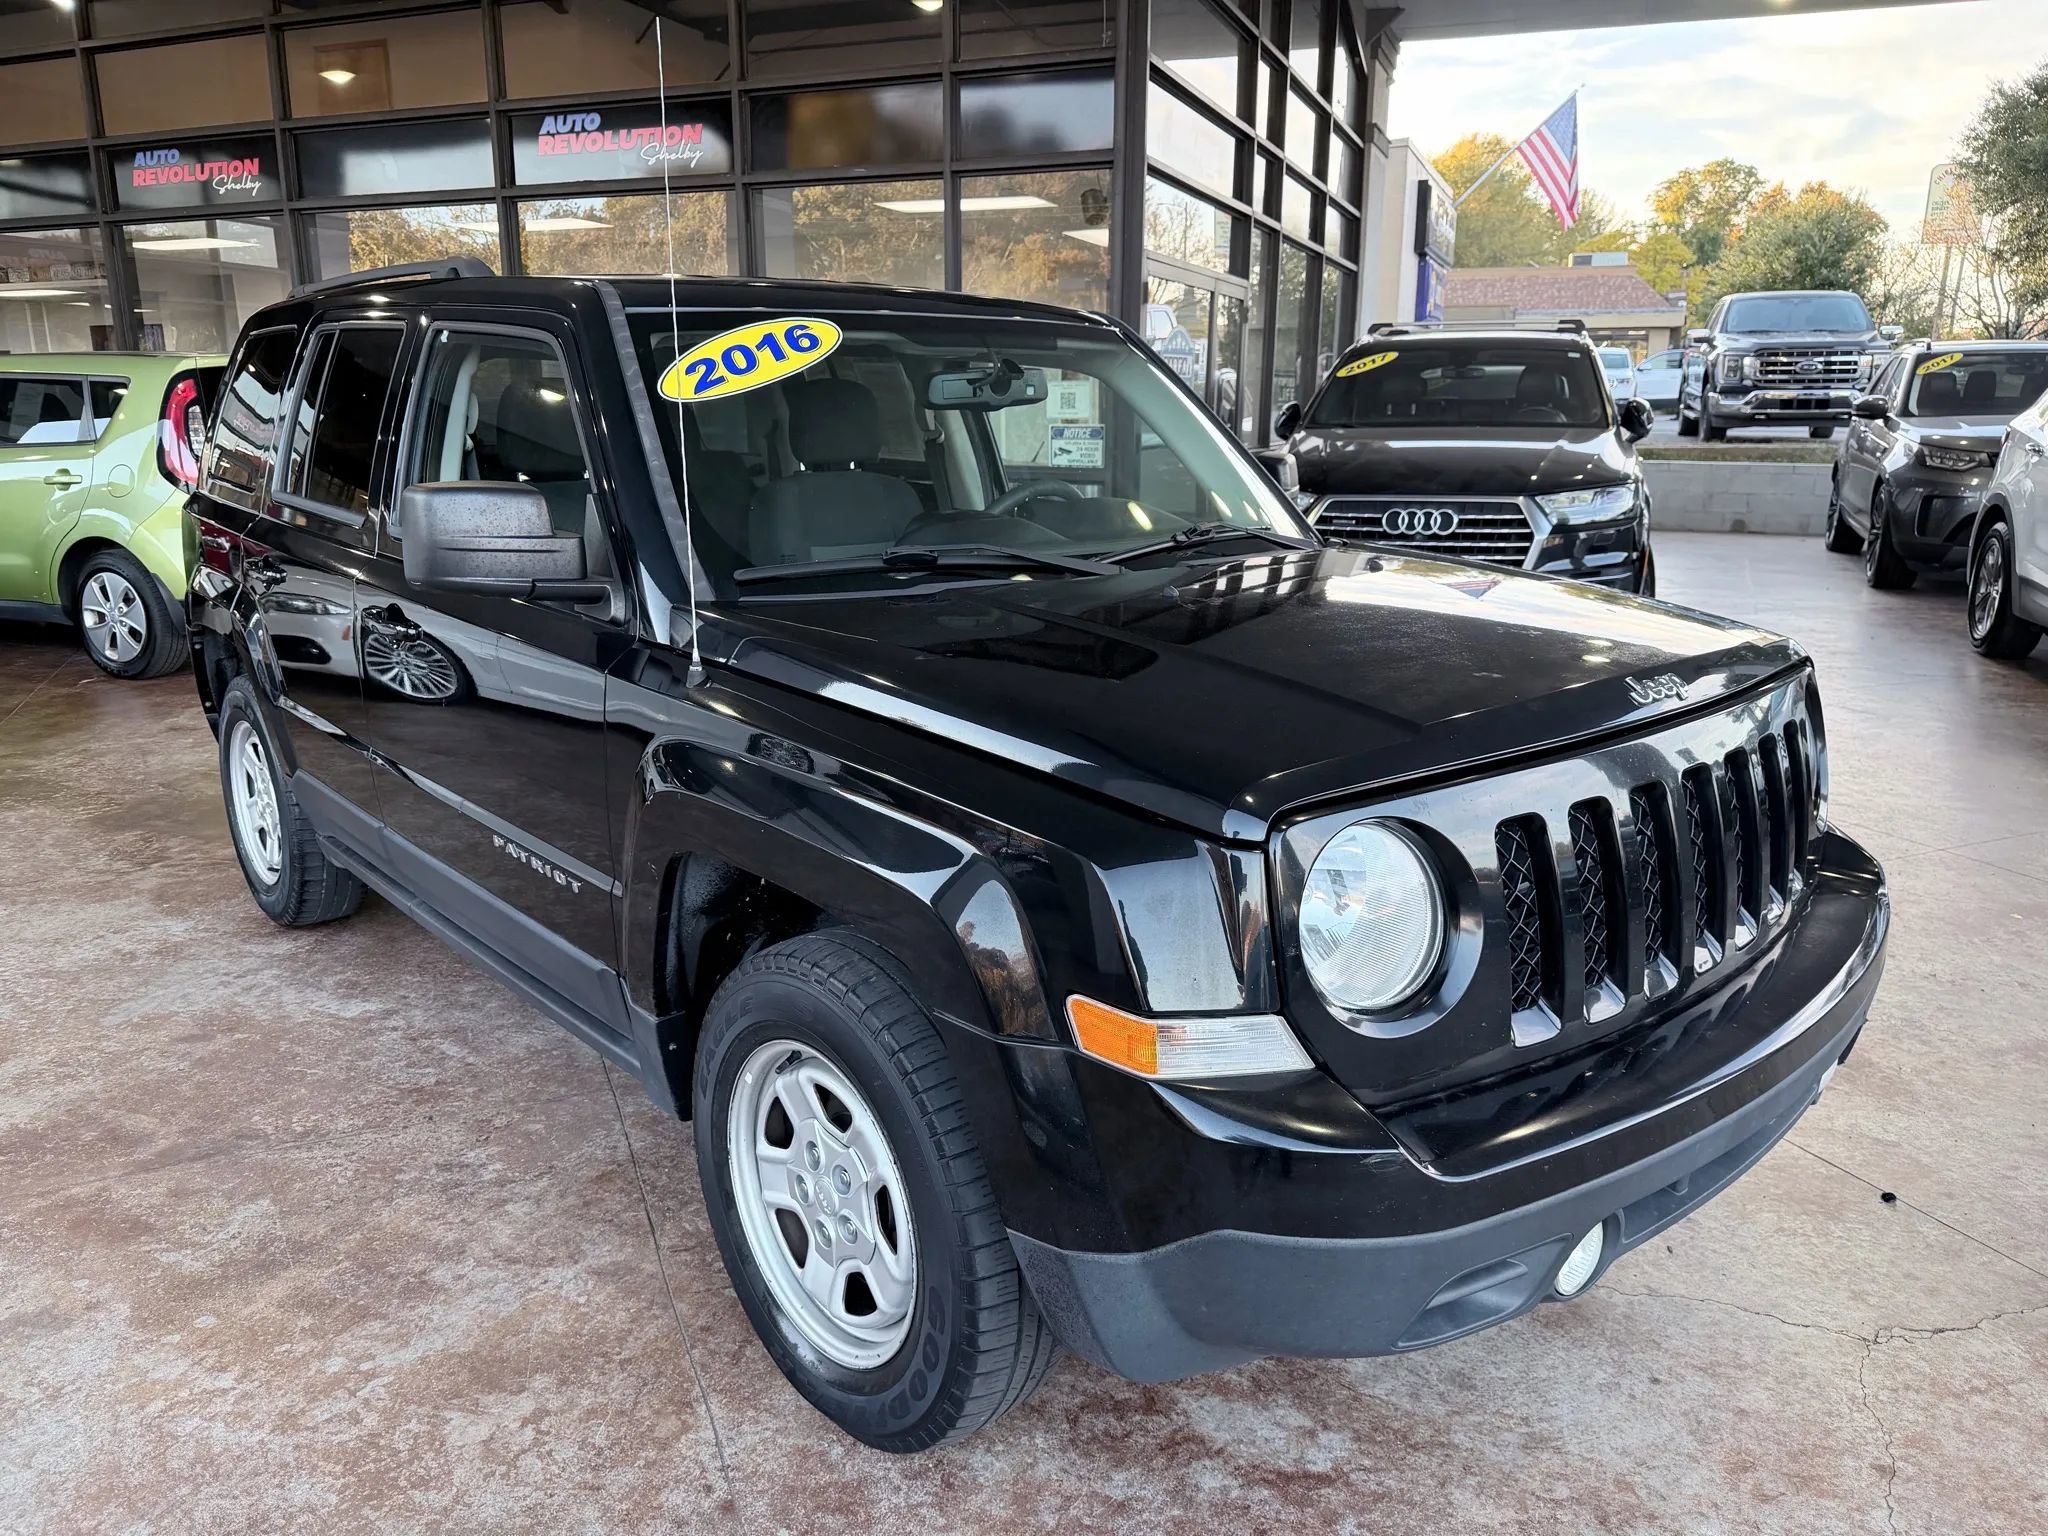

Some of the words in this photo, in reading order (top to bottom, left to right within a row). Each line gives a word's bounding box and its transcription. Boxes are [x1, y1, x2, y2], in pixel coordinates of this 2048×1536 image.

[539, 112, 602, 135] AUTO
[537, 124, 703, 156] REVOLUTION
[641, 138, 704, 168] Shelby
[134, 149, 180, 168] AUTO
[132, 158, 260, 188] REVOLUTION
[212, 170, 262, 197] Shelby
[684, 324, 823, 396] 2016
[1345, 353, 1389, 374] 2017
[1922, 353, 1954, 372] 2017
[1063, 427, 1091, 439] NOTICE
[1624, 672, 1690, 704] Jeep
[493, 834, 584, 894] PATRIOT
